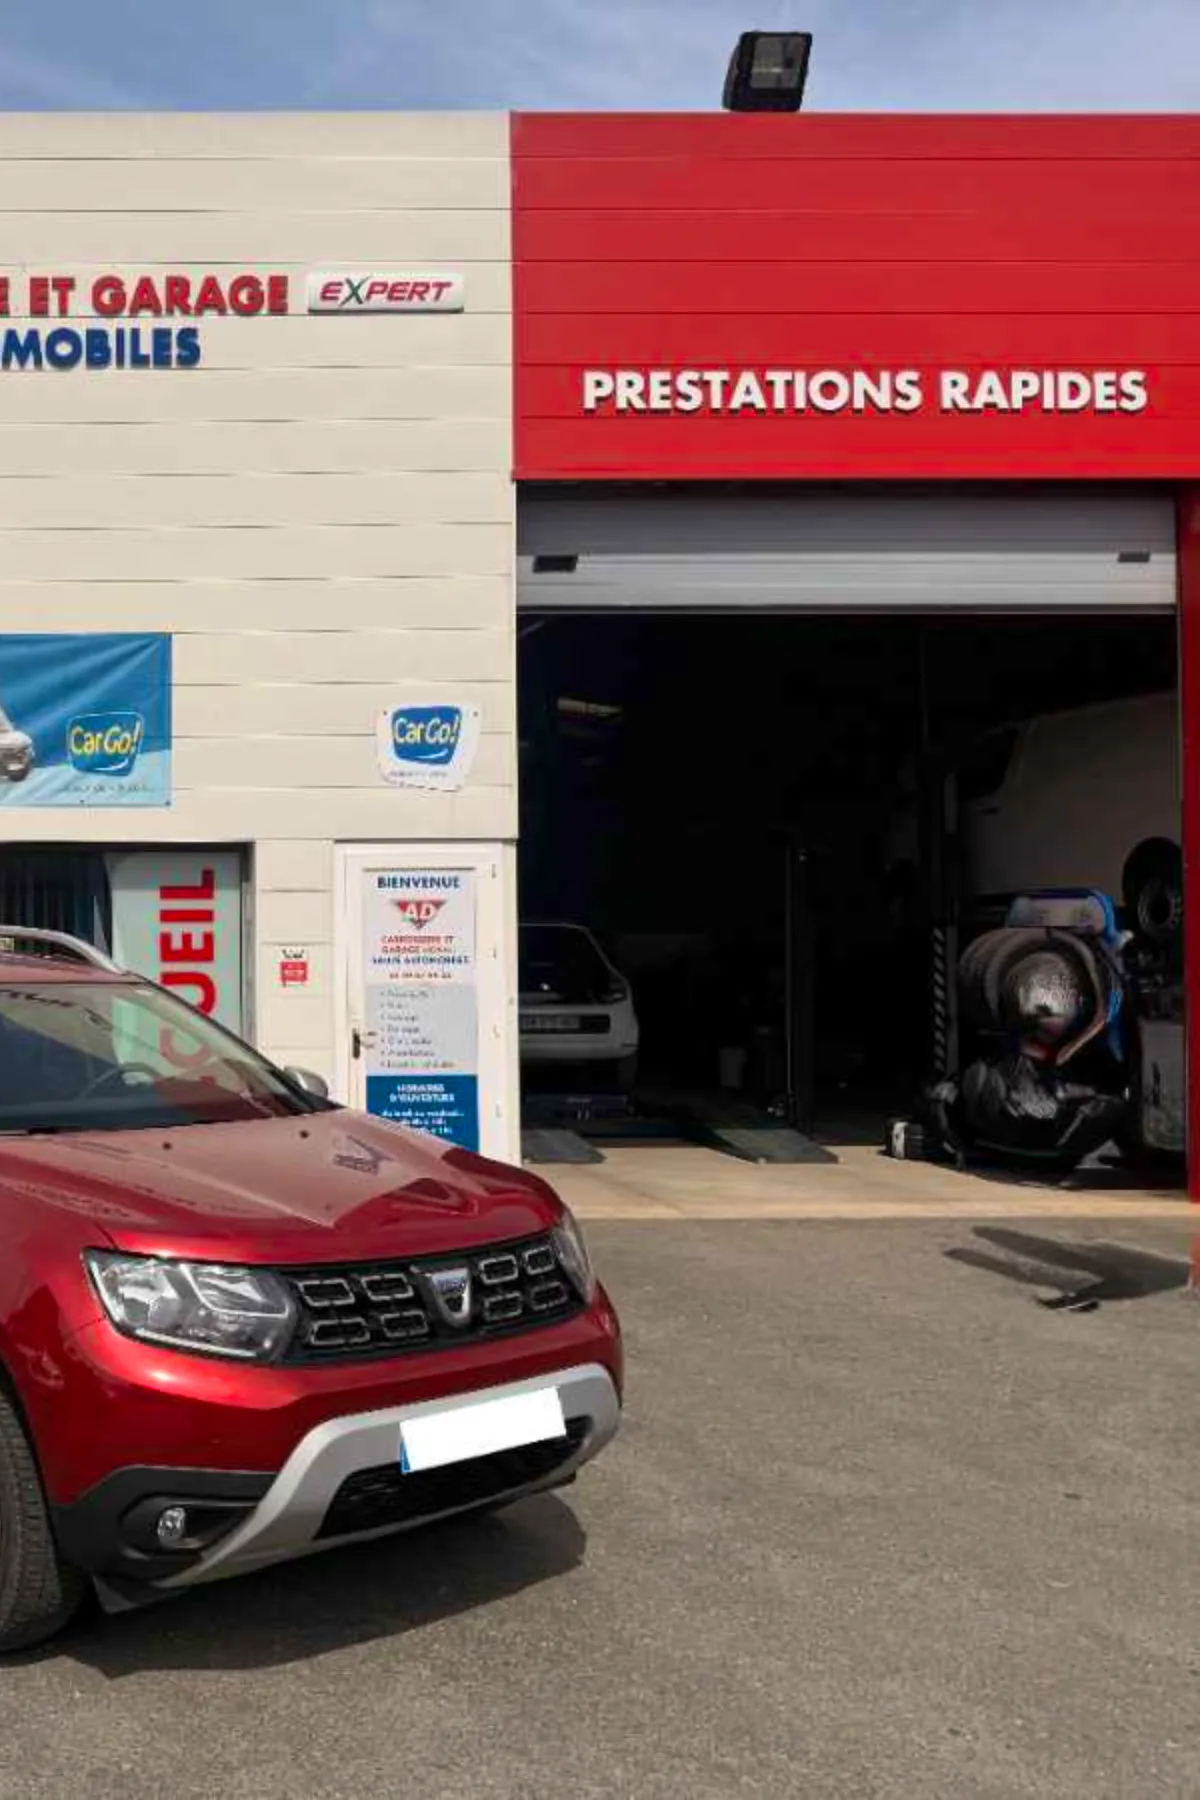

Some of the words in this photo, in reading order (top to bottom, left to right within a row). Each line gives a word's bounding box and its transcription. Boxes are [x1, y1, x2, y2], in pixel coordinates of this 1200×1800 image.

[29, 276, 76, 317] ET
[91, 275, 290, 316] GARAGE
[319, 277, 454, 307] EXPERT
[583, 369, 922, 412] PRESTATIONS
[940, 369, 1148, 412] RAPIDES
[377, 876, 461, 889] BIENVENUE
